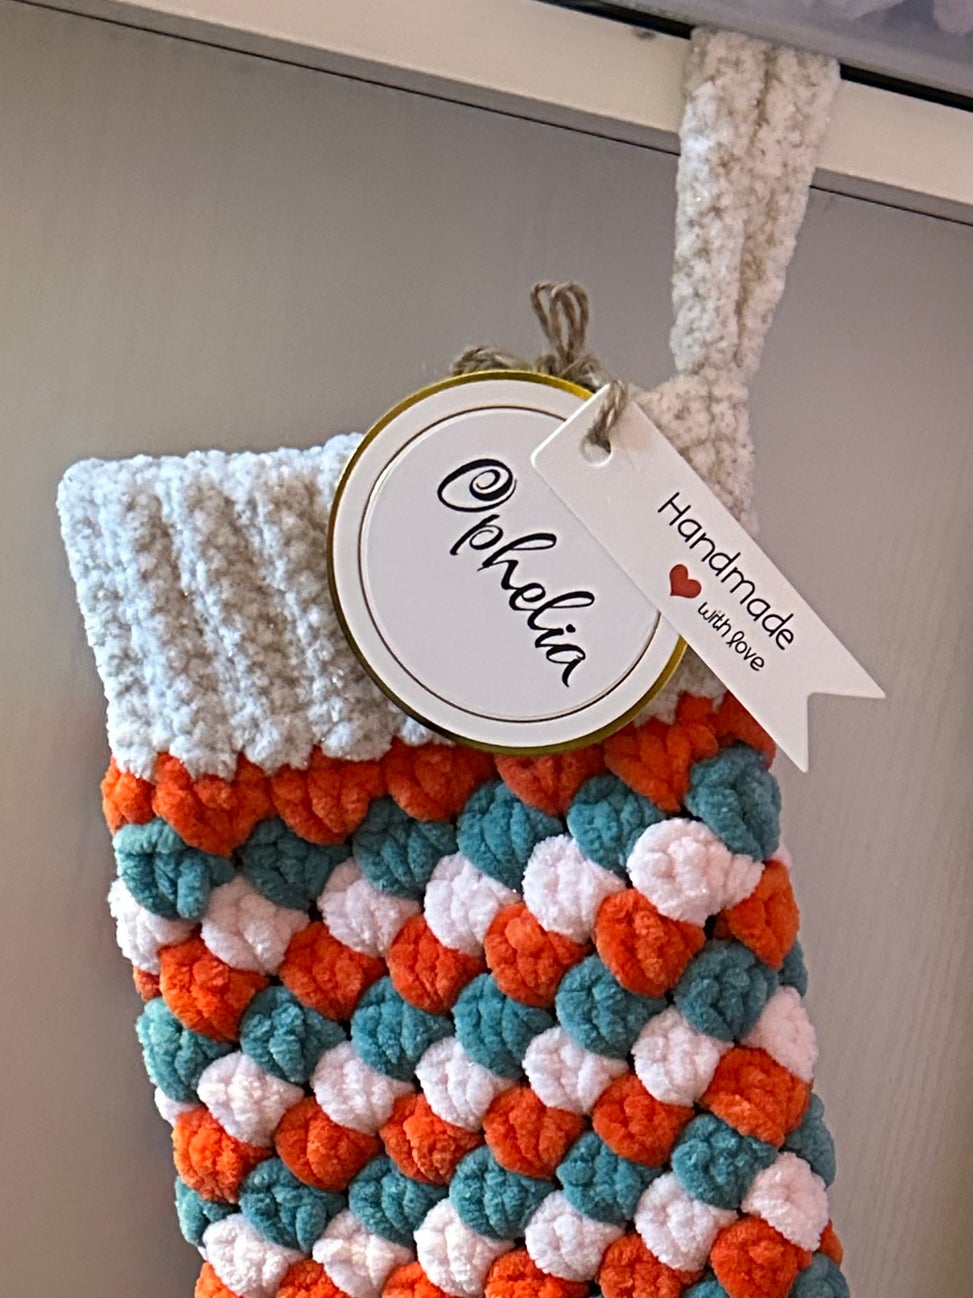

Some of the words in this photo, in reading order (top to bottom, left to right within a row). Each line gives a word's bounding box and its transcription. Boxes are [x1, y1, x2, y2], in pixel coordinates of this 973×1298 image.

[436, 457, 596, 688] Ophelia
[657, 491, 796, 651] Handmade
[697, 601, 732, 638] with
[725, 630, 765, 672] love
